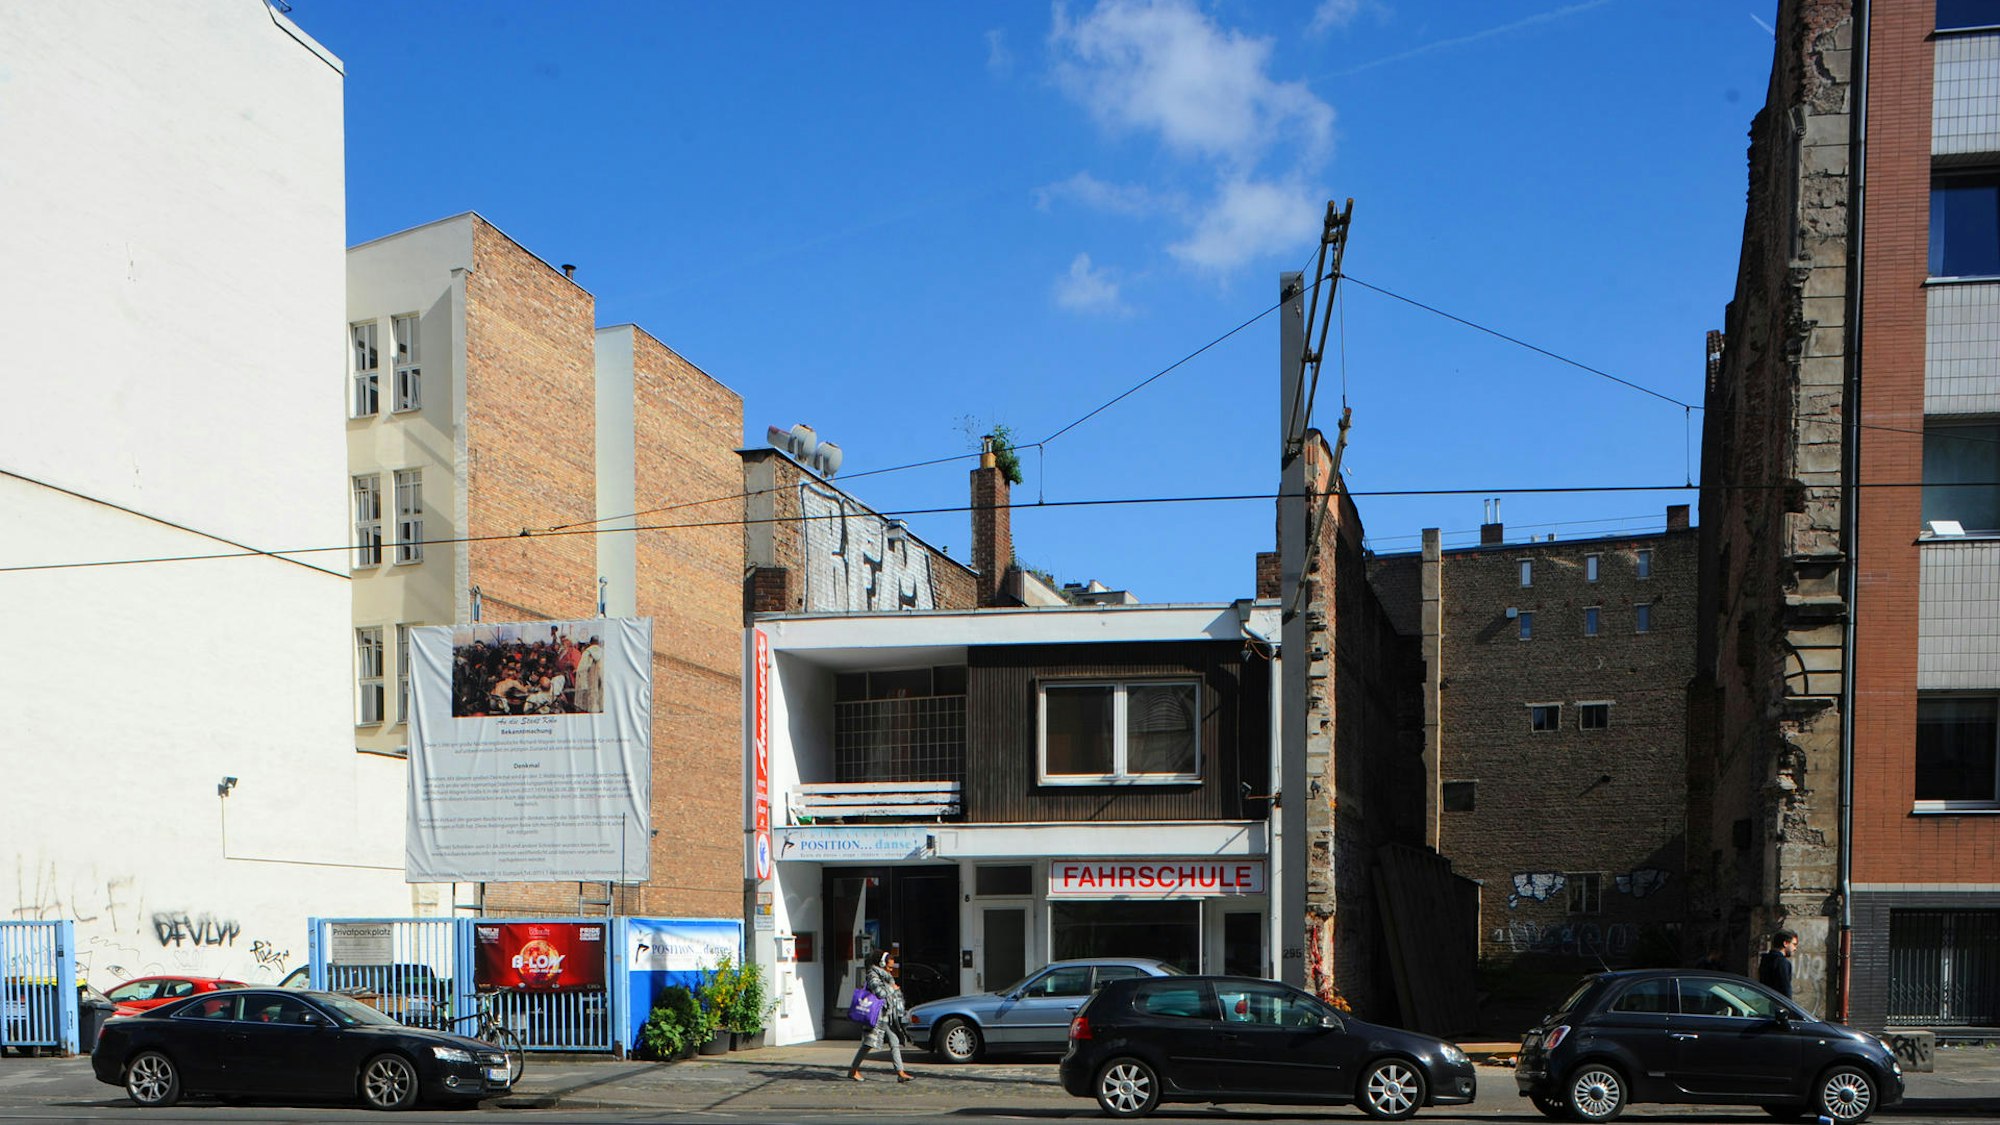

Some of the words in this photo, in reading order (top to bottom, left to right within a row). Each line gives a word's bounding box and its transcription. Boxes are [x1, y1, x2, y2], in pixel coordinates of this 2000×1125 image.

[501, 727, 553, 736] Bekanntmachung
[513, 761, 541, 769] Denkmal
[1063, 866, 1253, 888] FAHRSCHULE
[332, 928, 392, 938] Privatparkplatz
